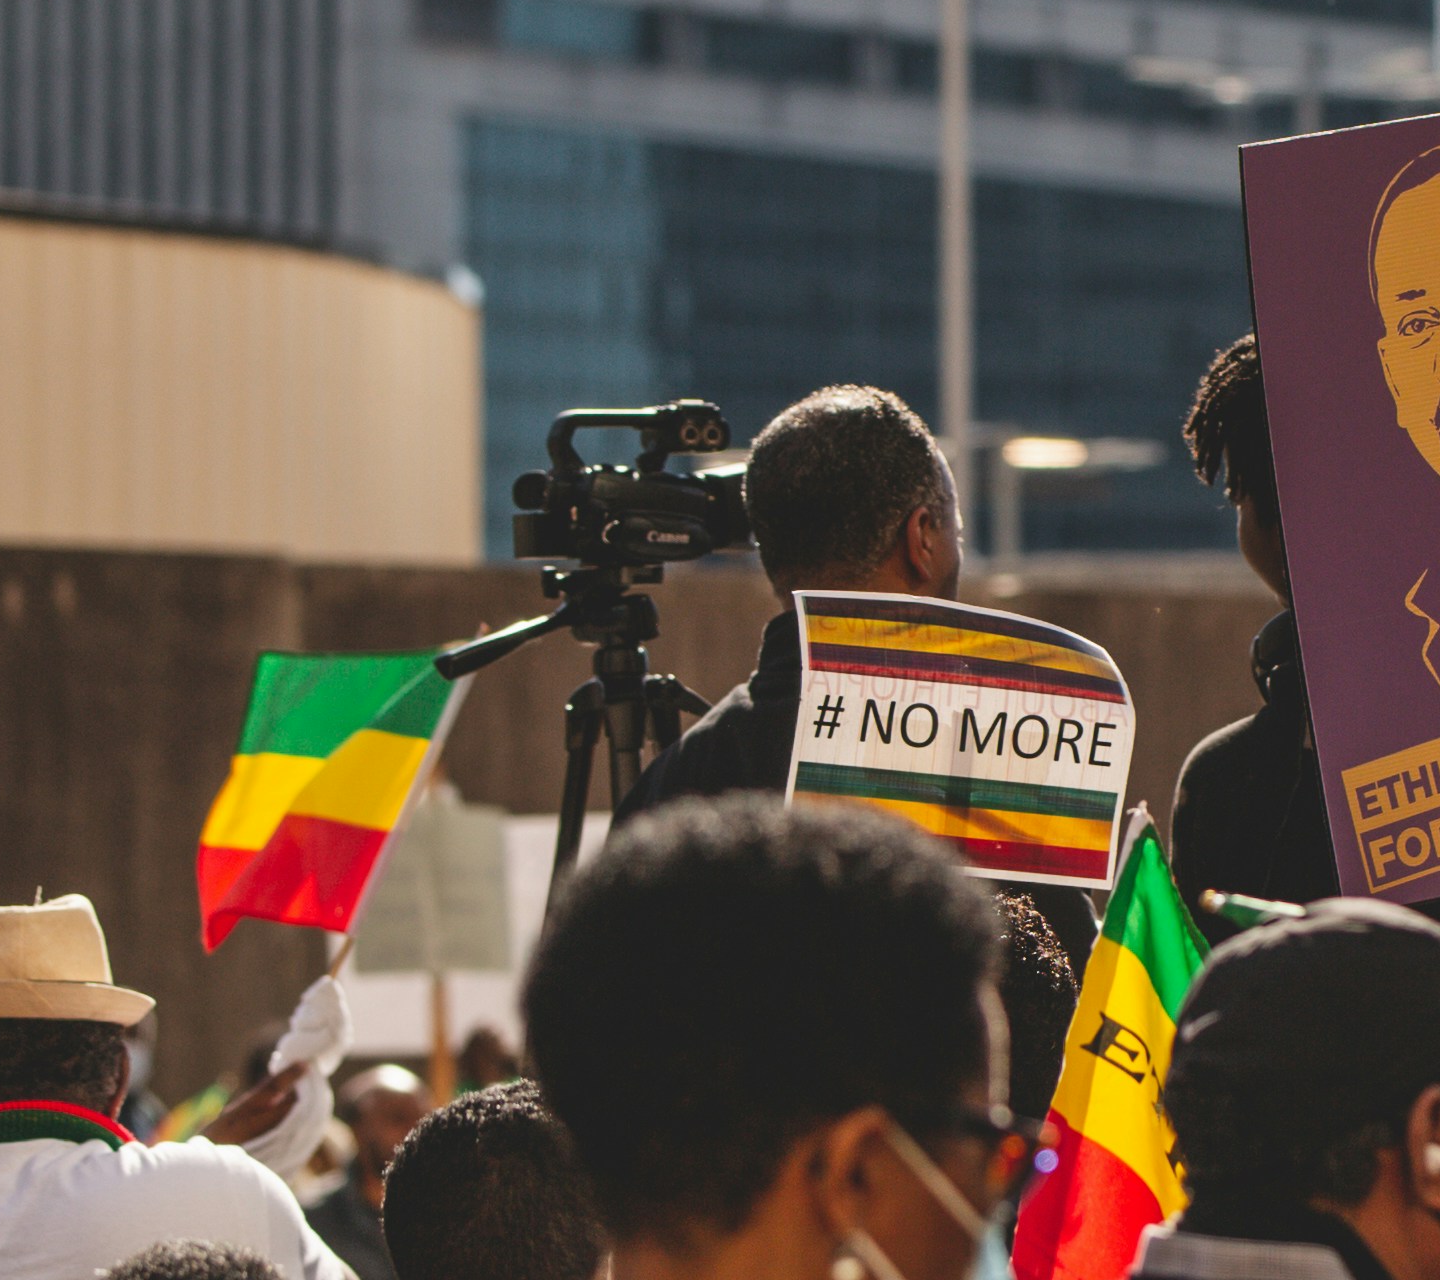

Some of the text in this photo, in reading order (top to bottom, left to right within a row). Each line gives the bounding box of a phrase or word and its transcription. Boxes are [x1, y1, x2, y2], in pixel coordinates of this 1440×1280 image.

[813, 694, 1118, 768] # NO MORE
